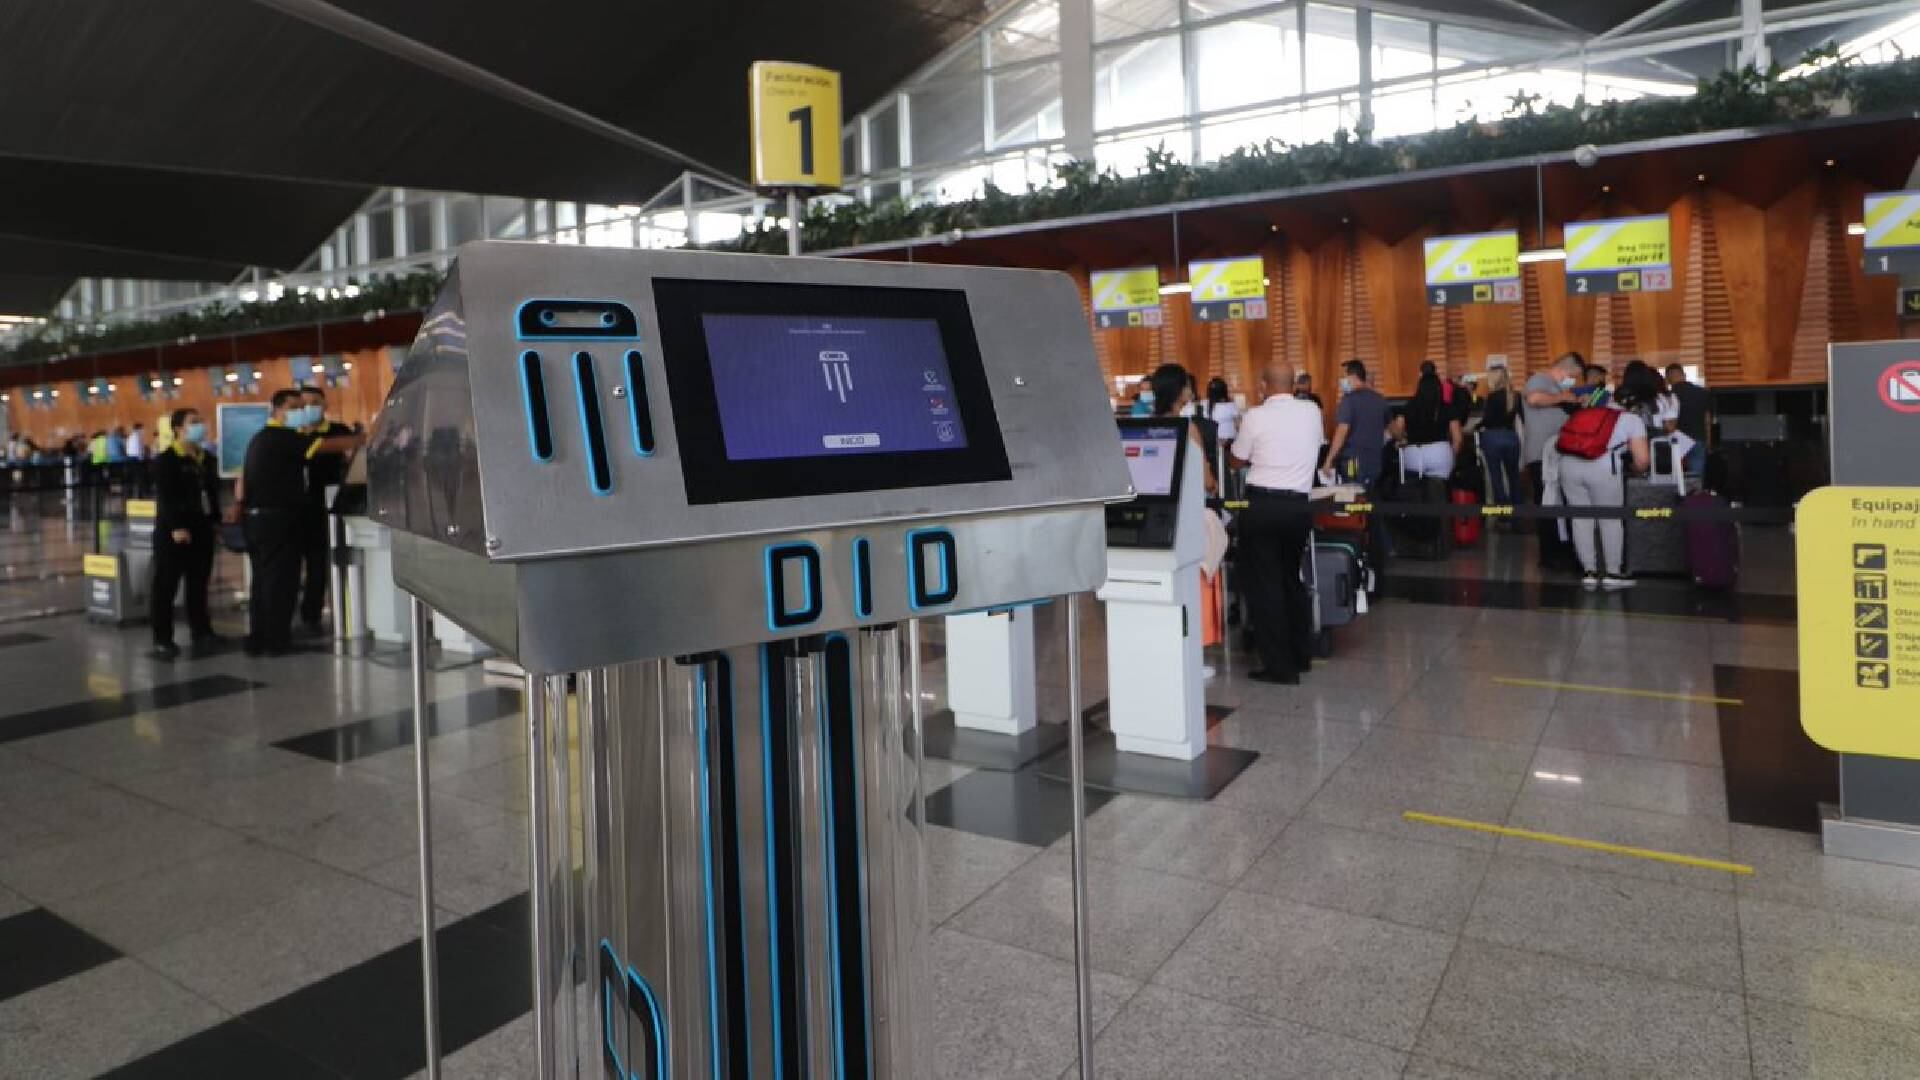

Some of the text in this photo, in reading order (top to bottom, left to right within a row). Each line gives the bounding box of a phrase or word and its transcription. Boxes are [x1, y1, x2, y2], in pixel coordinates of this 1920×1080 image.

[789, 105, 814, 175] 1
[1878, 255, 1888, 272] 1
[1575, 278, 1588, 292] 2
[1434, 290, 1447, 304] 3
[1199, 306, 1209, 319] 4
[1872, 516, 1916, 529] hand
